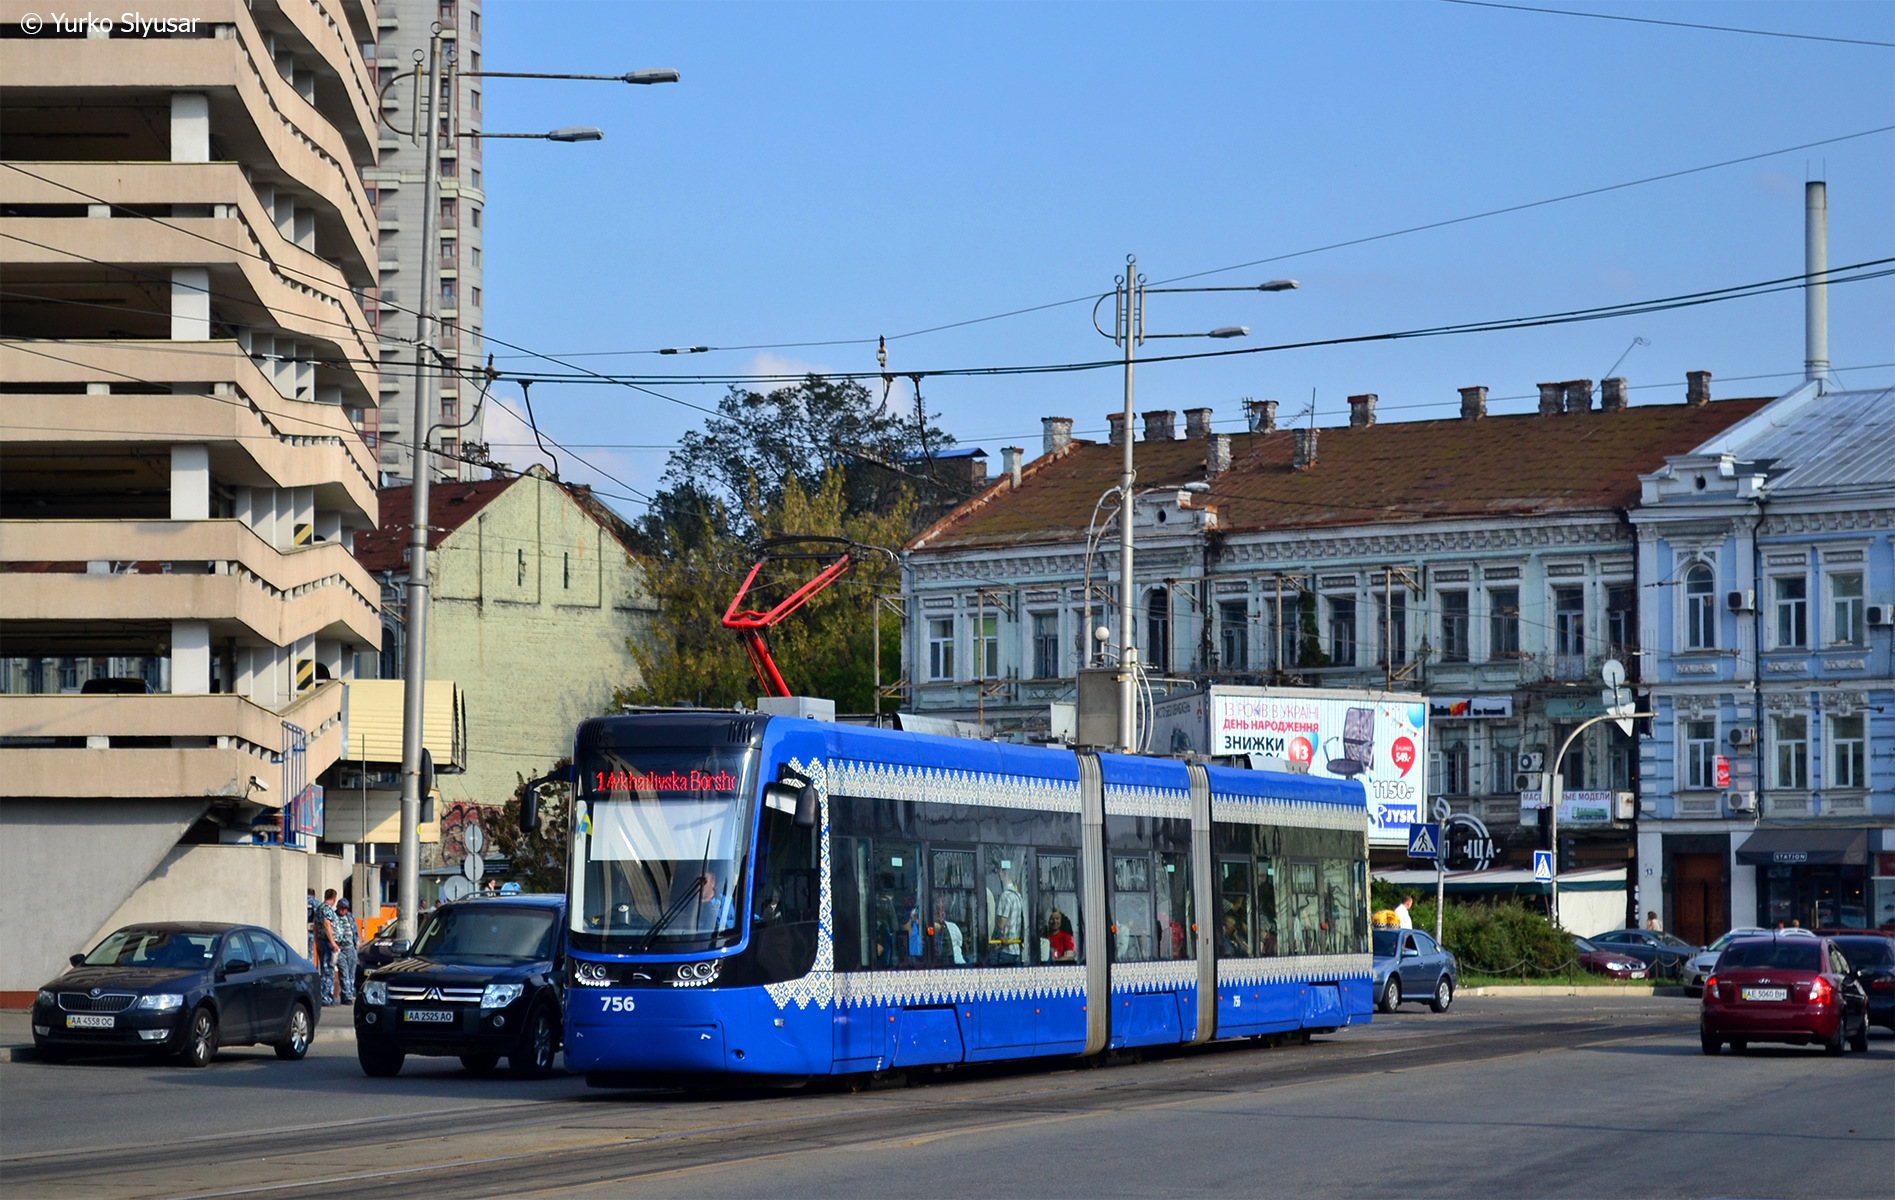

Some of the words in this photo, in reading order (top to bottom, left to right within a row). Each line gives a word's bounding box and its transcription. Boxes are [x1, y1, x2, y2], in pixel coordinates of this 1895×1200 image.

[1224, 702, 1235, 717] 13
[1271, 703, 1279, 719] В
[1280, 703, 1319, 720] УКРАЇНІ
[1223, 718, 1250, 731] ДЕНЬ
[1251, 720, 1319, 734] НАРОДЖЕННЯ
[1224, 735, 1285, 752] ЗНИЖКИ
[1293, 745, 1309, 760] 13
[596, 771, 606, 792] 1
[1579, 792, 1610, 804] МОДЕЛИ
[1385, 809, 1416, 824] JYSK
[1775, 853, 1805, 861] STATION
[600, 996, 635, 1012] 756
[71, 1016, 82, 1025] AA
[101, 1017, 113, 1026] OC
[409, 1011, 420, 1021] AA
[421, 1012, 439, 1021] 2525
[440, 1012, 452, 1021] AO
